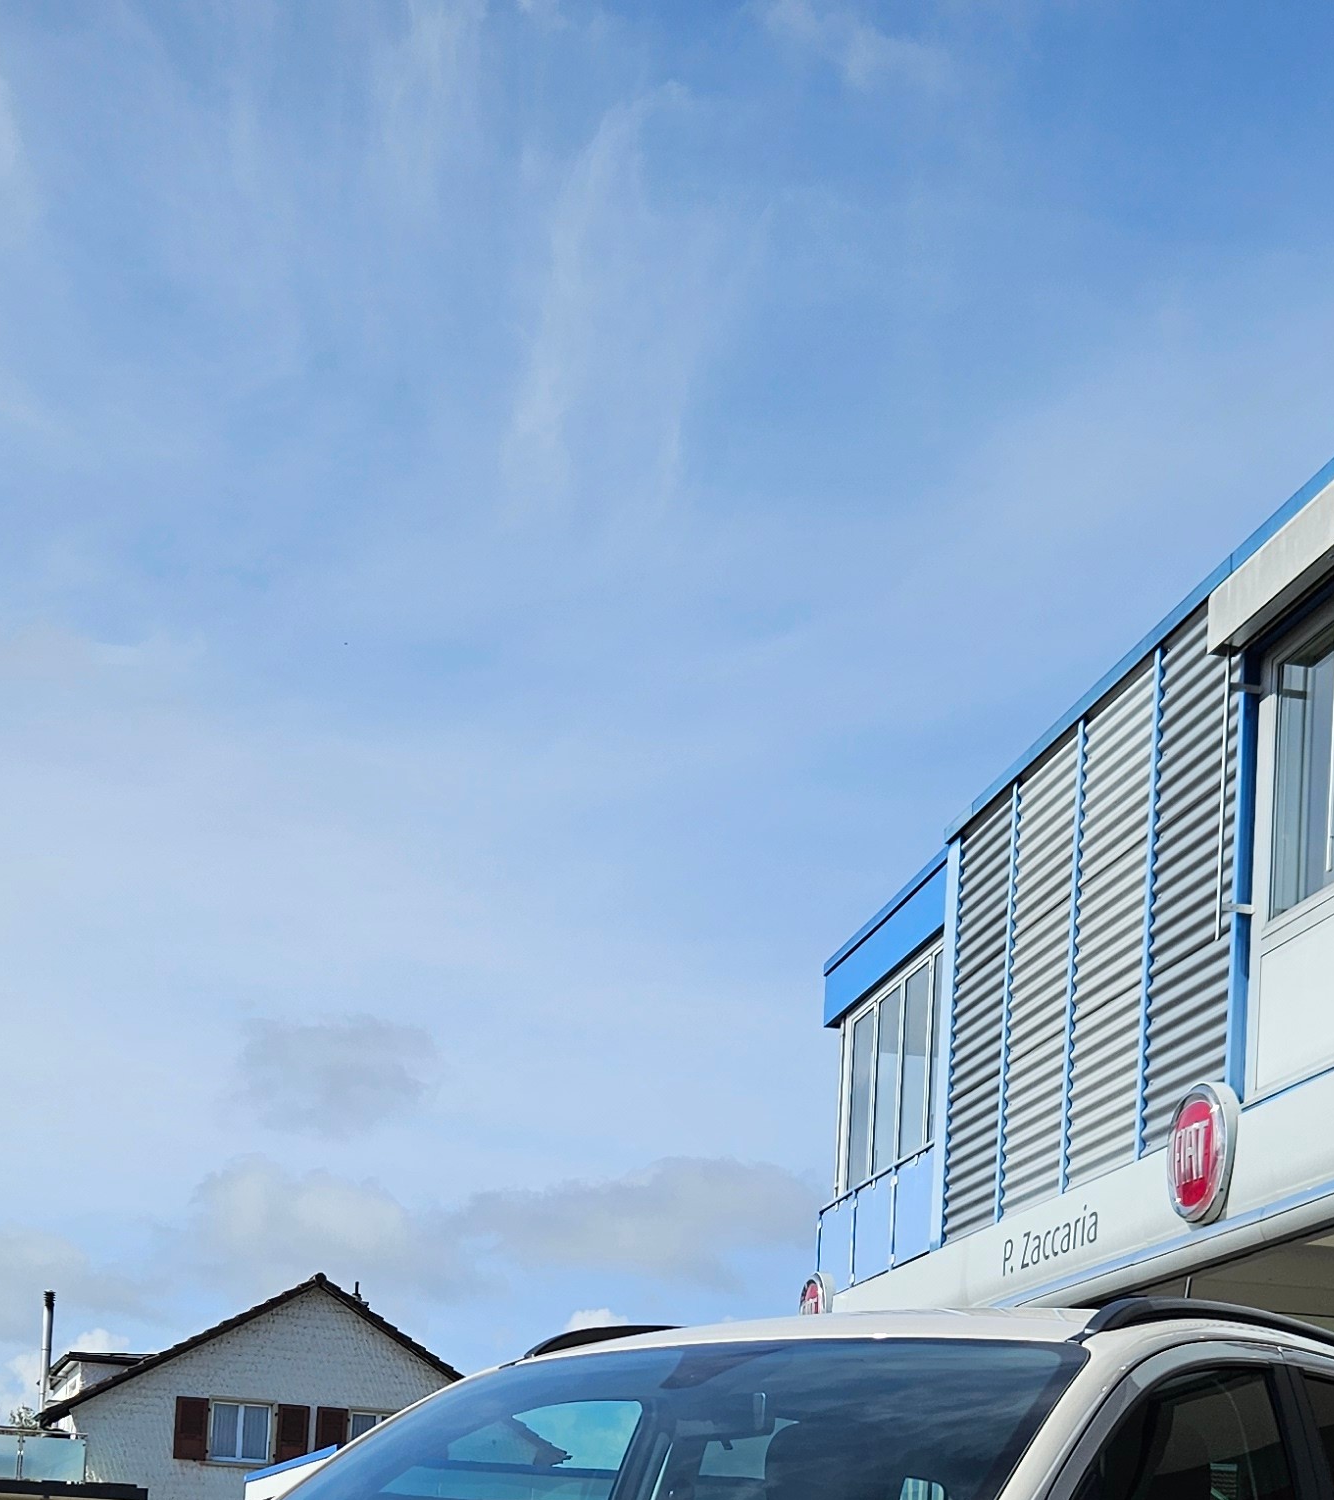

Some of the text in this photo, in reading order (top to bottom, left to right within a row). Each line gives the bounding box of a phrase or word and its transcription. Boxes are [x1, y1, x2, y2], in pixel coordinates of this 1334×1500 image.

[1174, 1118, 1210, 1188] FIAT
[1002, 1204, 1099, 1277] P. Zaccaria
